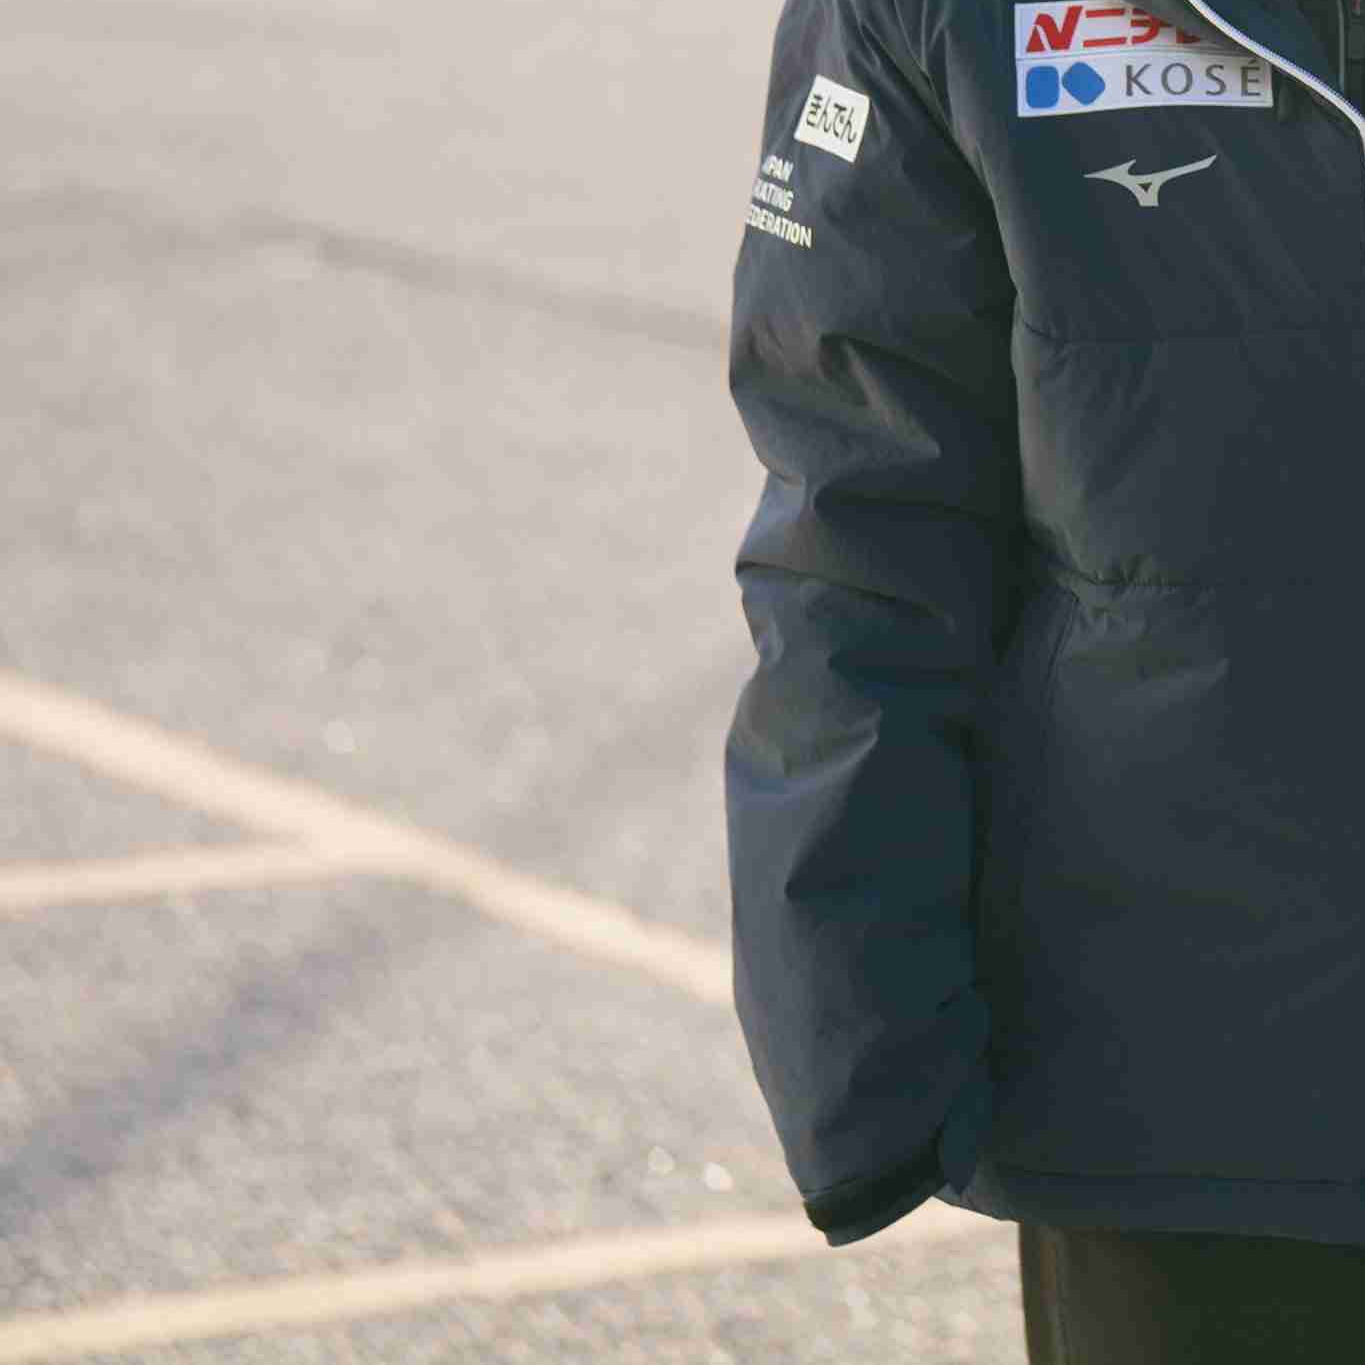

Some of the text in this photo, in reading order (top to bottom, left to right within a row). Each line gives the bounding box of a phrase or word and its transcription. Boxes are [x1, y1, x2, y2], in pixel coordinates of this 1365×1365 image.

[1125, 58, 1263, 97] KOSÉ
[806, 93, 857, 144] きんでん
